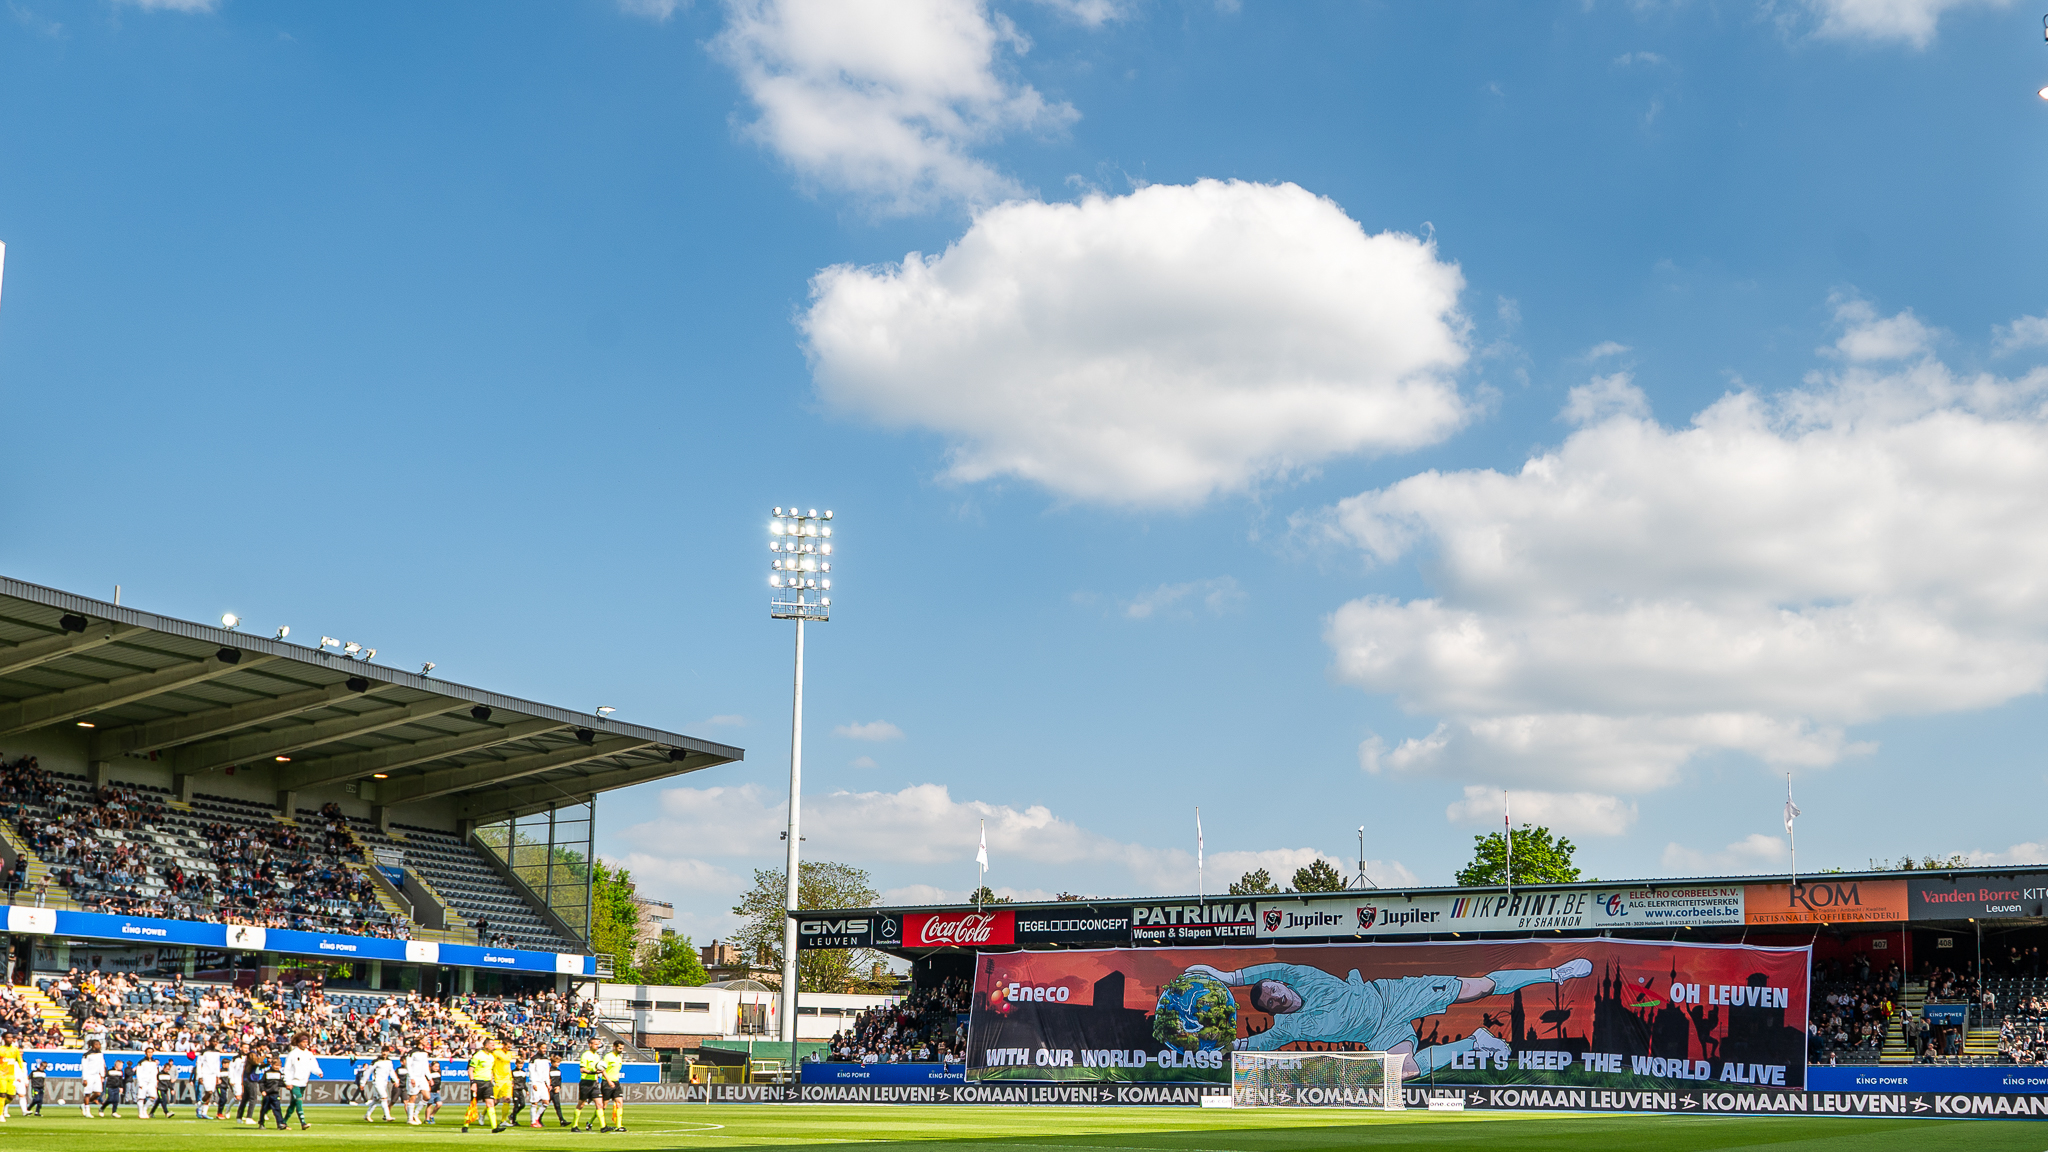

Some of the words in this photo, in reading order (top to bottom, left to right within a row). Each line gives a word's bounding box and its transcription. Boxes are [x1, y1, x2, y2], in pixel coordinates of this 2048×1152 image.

[1629, 890, 1670, 900] ELECTRO
[1671, 889, 1718, 899] CORBEELS
[1720, 888, 1739, 897] N.V.
[1788, 883, 1863, 911] ROM
[1921, 889, 1976, 903] Vanden
[1979, 888, 2020, 902] Borre
[1628, 901, 1646, 909] ALG.
[1647, 898, 1739, 908] ELEKTRICITEITSWERKEN
[1985, 904, 2022, 913] Leuven
[1132, 903, 1256, 926] PATRIMA
[1379, 908, 1441, 927] Jupiler
[1645, 906, 1739, 918] www.corbeels.be
[1752, 914, 1809, 923] ARTISANALE
[1812, 911, 1900, 921] KOFFIEBRANDERIJ
[1283, 911, 1344, 930] Jupiler
[1518, 917, 1532, 928] BY
[1534, 916, 1582, 928] SHANNON
[122, 926, 141, 935] KING
[142, 928, 168, 937] POWER
[800, 919, 869, 935] GMS
[1133, 928, 1166, 939] Wonen
[1168, 927, 1176, 938] &
[1178, 926, 1212, 939] Slapen
[1214, 925, 1256, 937] VELTEM
[319, 942, 335, 950] KING
[336, 944, 357, 952] POWER
[809, 936, 859, 946] LEUVEN
[1873, 940, 1887, 949] 407
[1938, 938, 1953, 948] 408
[1008, 982, 1070, 1002] Eneco
[1670, 982, 1699, 1003] OH
[1708, 983, 1789, 1009] LEUVEN
[986, 1047, 1029, 1067] WITH
[1035, 1048, 1074, 1068] OUR
[1082, 1049, 1223, 1070] WORLD-CLASS
[55, 1063, 82, 1072] POWE
[1451, 1050, 1509, 1070] LET'S
[1518, 1050, 1573, 1071] KEEP
[1581, 1053, 1623, 1073] THE
[1631, 1055, 1711, 1081] WORLD
[1720, 1062, 1787, 1086] ALIVE
[1856, 1077, 1878, 1085] KING
[1879, 1077, 1909, 1085] POWER
[2002, 1077, 2026, 1086] KING
[2027, 1078, 2048, 1086] POW
[645, 1085, 712, 1101] KOMAAN
[716, 1085, 785, 1101] LEUVEN!
[801, 1086, 870, 1101] KOMAAN
[874, 1086, 936, 1102] LEUVEN!
[954, 1087, 1028, 1102] KOMAAN
[1032, 1087, 1098, 1103] LEUVEN!
[1118, 1087, 1199, 1103] KOMAAN
[1297, 1088, 1384, 1104] KOMAAN
[1490, 1090, 1588, 1107] KOMAAN
[1591, 1091, 1677, 1110] LEUVEN!
[1702, 1092, 1808, 1112] KOMAAN
[1812, 1094, 1907, 1114] LEUVEN!
[1935, 1095, 2048, 1115] KOMAAN
